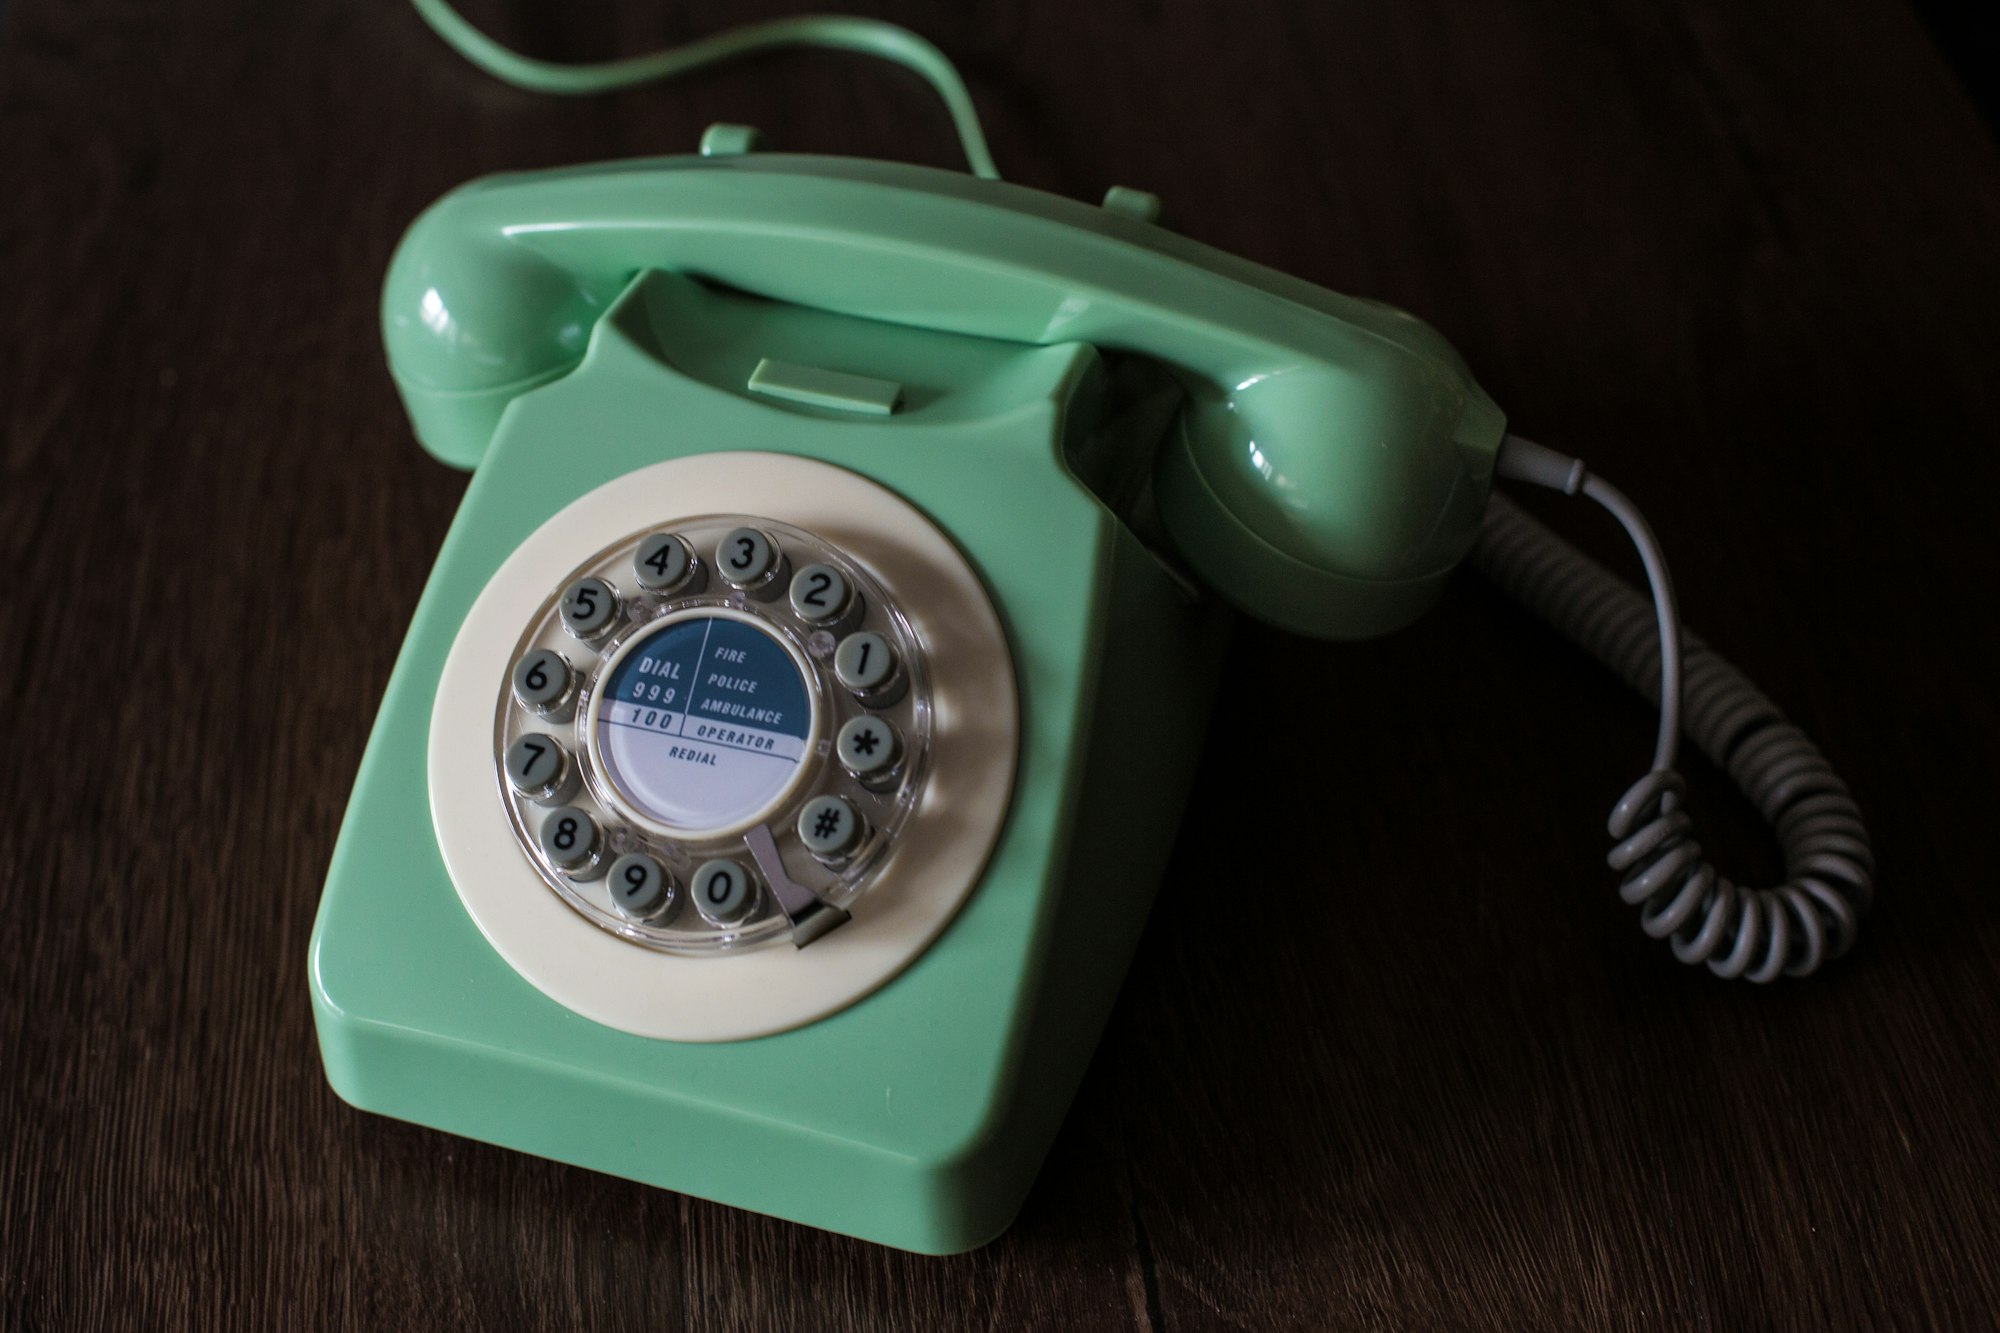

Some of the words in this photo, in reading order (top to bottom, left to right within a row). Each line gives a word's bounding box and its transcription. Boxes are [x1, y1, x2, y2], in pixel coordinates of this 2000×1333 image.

[645, 545, 670, 576] 4
[731, 538, 754, 569] 3
[573, 588, 598, 620] 5
[804, 573, 831, 606] 2
[638, 656, 680, 680] DIAL
[715, 647, 747, 664] FIRE
[858, 643, 870, 675] 1
[526, 660, 547, 690] 6
[707, 673, 758, 694] POLICE
[633, 681, 676, 704] 999
[700, 698, 783, 725] AMBULANCE
[631, 708, 672, 729] 100
[697, 725, 775, 750] OPERATOR
[523, 743, 545, 776] 7
[669, 746, 716, 766] REDIAL
[554, 818, 577, 850] 8
[625, 865, 647, 896] 9
[708, 871, 732, 904] 0
